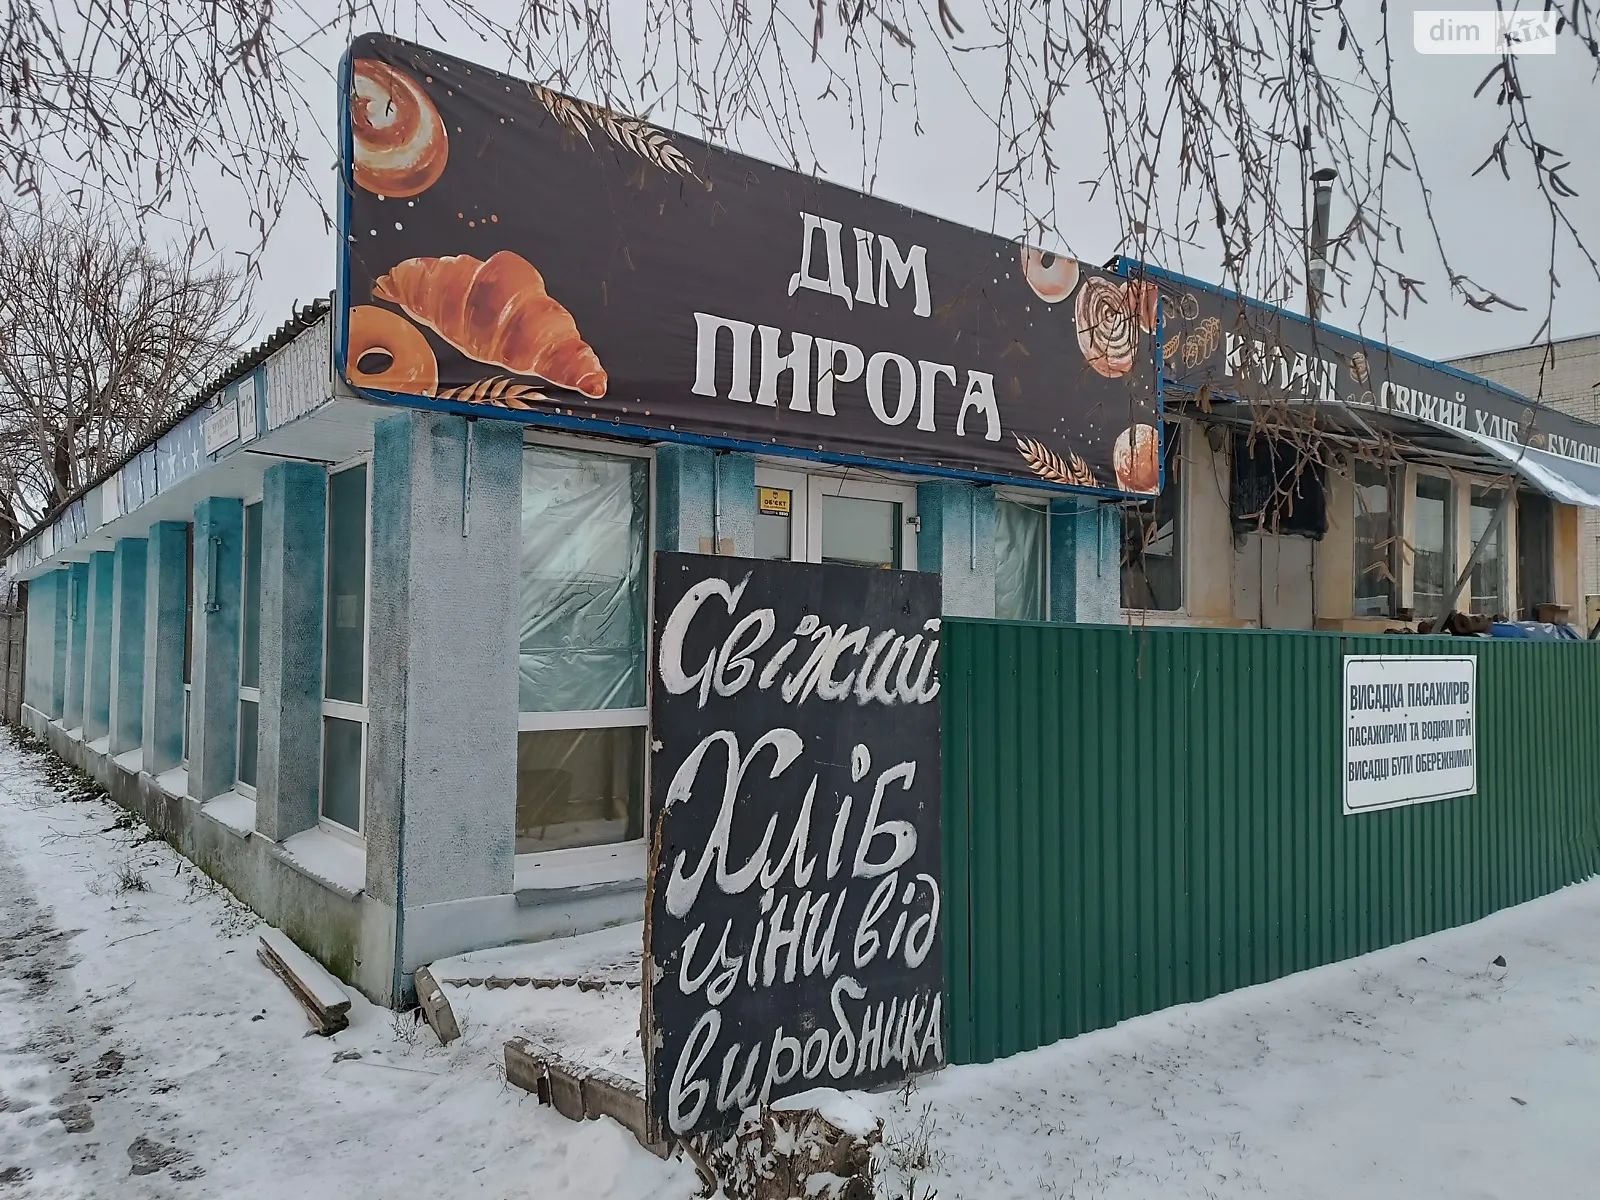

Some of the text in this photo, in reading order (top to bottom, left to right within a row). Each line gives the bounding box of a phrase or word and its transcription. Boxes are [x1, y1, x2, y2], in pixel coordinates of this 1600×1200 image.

[788, 211, 931, 317] ДІМ
[691, 312, 1001, 441] ПИРОГА
[1381, 381, 1519, 445] СВІЖИЙ ХЛІБ
[659, 571, 941, 709] Свіжий
[1348, 718, 1471, 747] ПАСАЖИРАМ ТА ВОДІЯМ ПРИ
[1350, 681, 1470, 712] ВИСАДКА ПАСАЖИРІВ
[1348, 748, 1472, 782] ВИСАДЦІ БУТИ ОБЕРЕЖНИМИ
[679, 871, 940, 1006] ціни від
